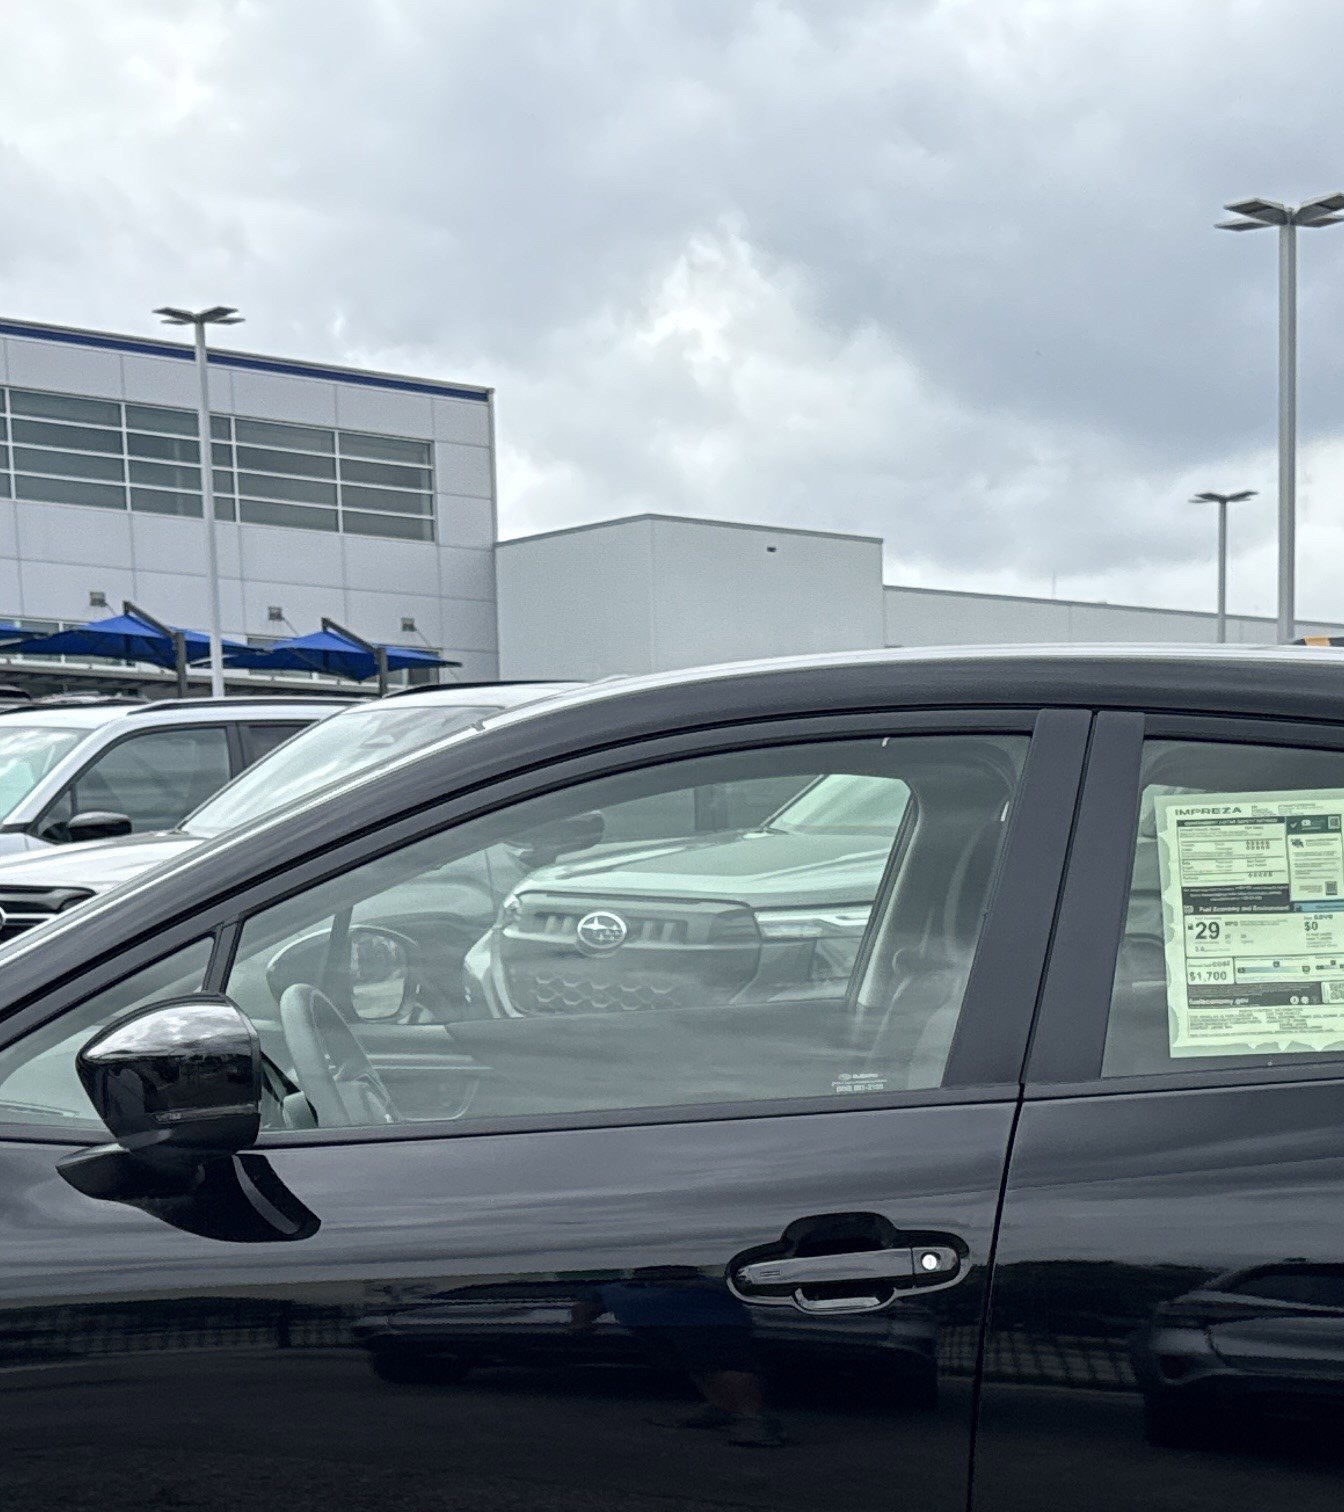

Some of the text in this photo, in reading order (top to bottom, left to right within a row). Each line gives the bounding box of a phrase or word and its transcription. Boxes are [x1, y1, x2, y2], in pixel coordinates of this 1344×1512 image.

[1174, 806, 1242, 816] IMPREZA
[1194, 921, 1220, 940] 29
[1188, 971, 1228, 982] $1,700
